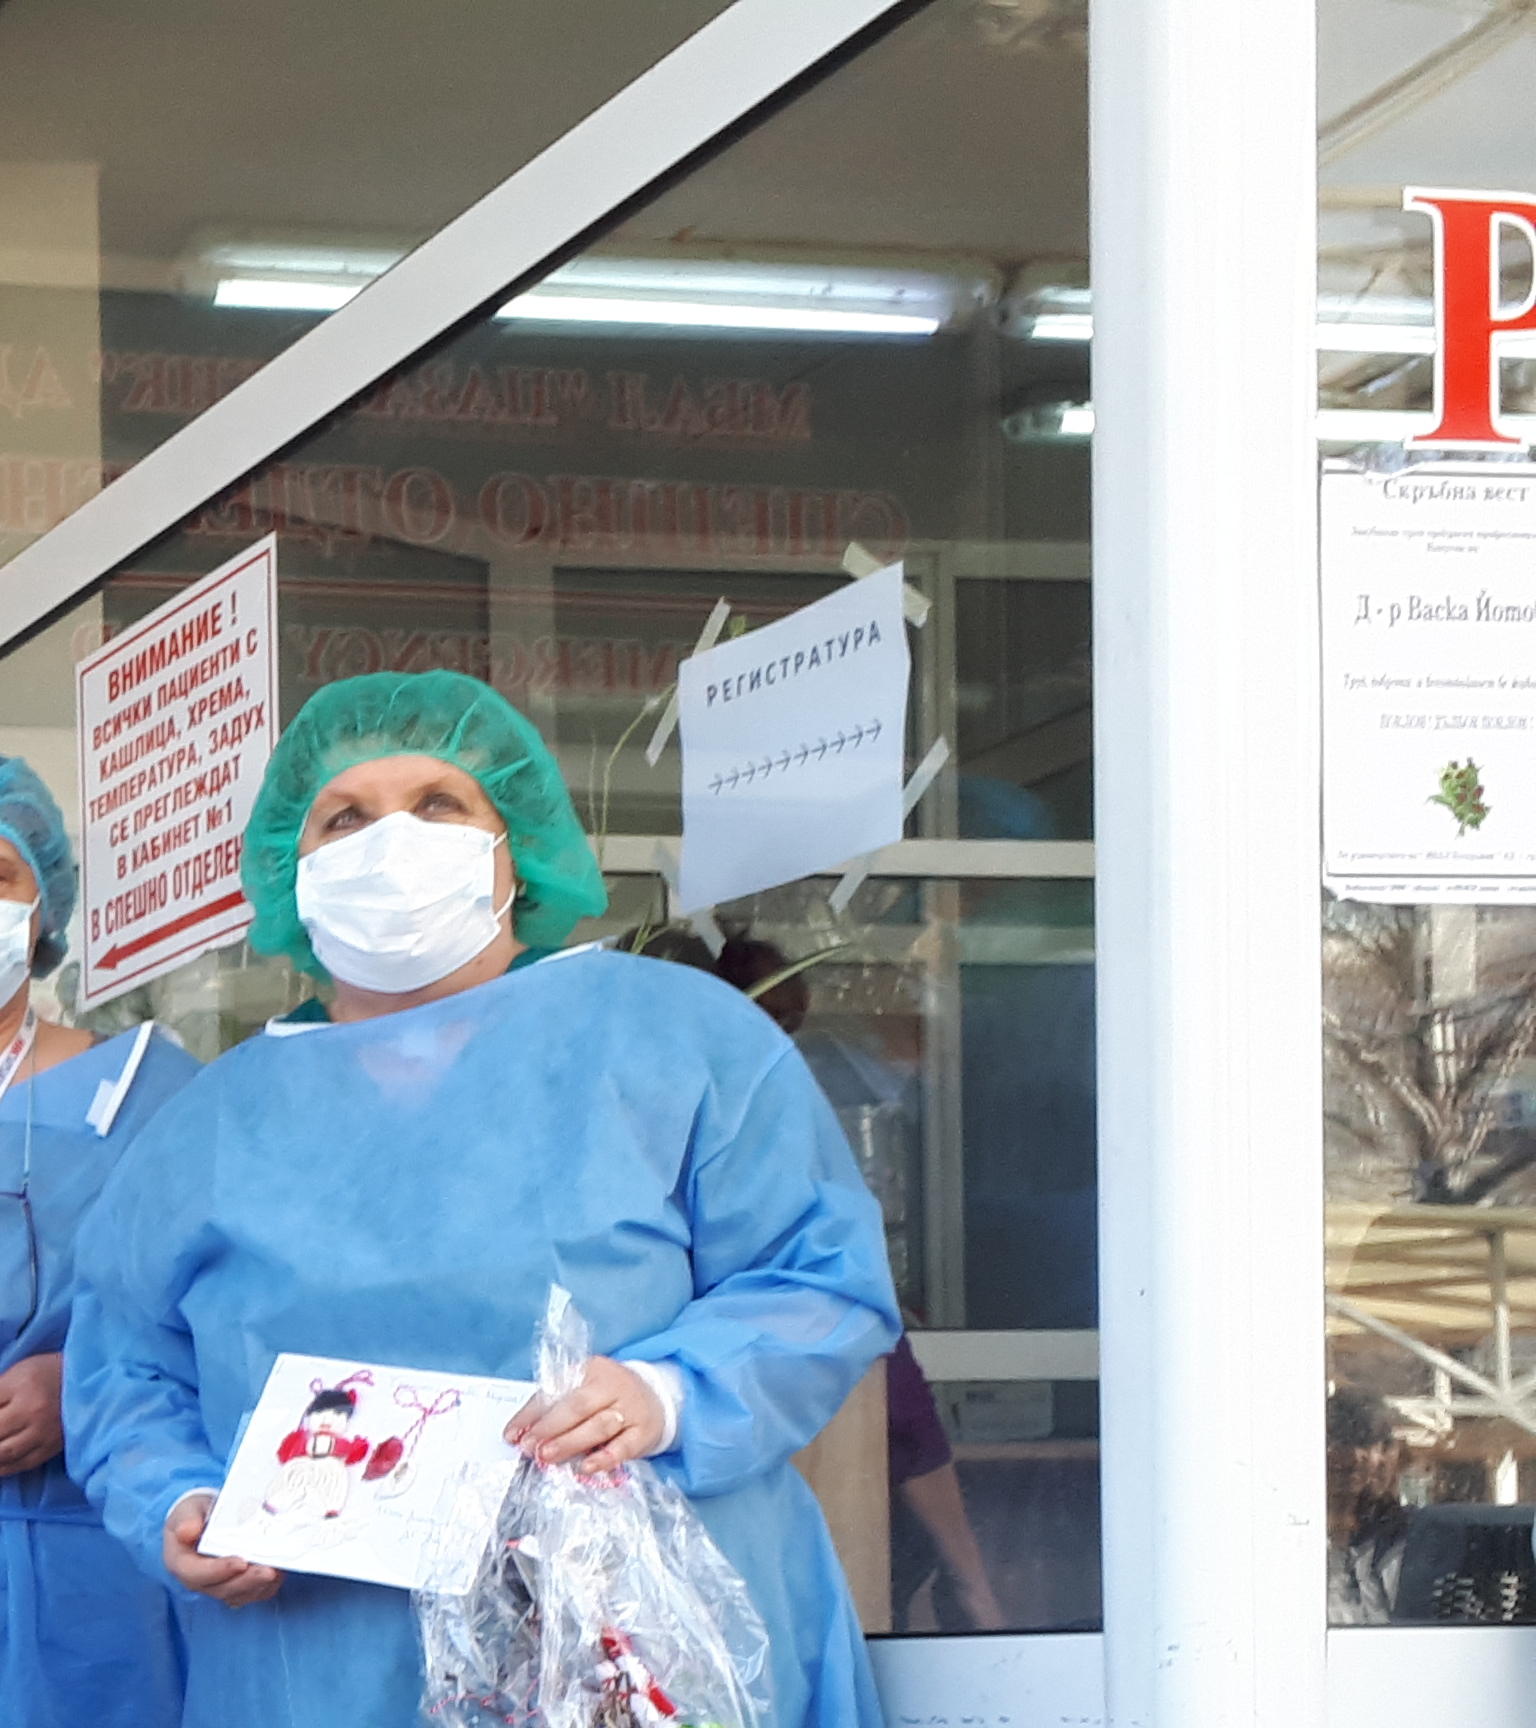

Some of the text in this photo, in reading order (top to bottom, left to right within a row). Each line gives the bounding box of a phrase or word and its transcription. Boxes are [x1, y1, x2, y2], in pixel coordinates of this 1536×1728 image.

[92, 693, 153, 751] ВСИЧКИ
[157, 637, 240, 711] ПАЦИЕНТИ
[246, 628, 258, 656] С
[107, 601, 223, 703] ВНИМАНИЕ
[705, 620, 883, 708] РЕГИСТРАТУРА
[89, 701, 266, 824] ТЕМПЕРАТУРА, ЗАДУХ
[99, 676, 251, 782] КАШЛИЦА, ХРЕМА,
[109, 753, 241, 848] СЕ ПРЕГЛЕЖДАТ
[116, 854, 127, 881] В
[132, 813, 201, 873] КАБИНЕТ
[91, 908, 101, 944] В
[105, 871, 168, 935] СПЕШНО
